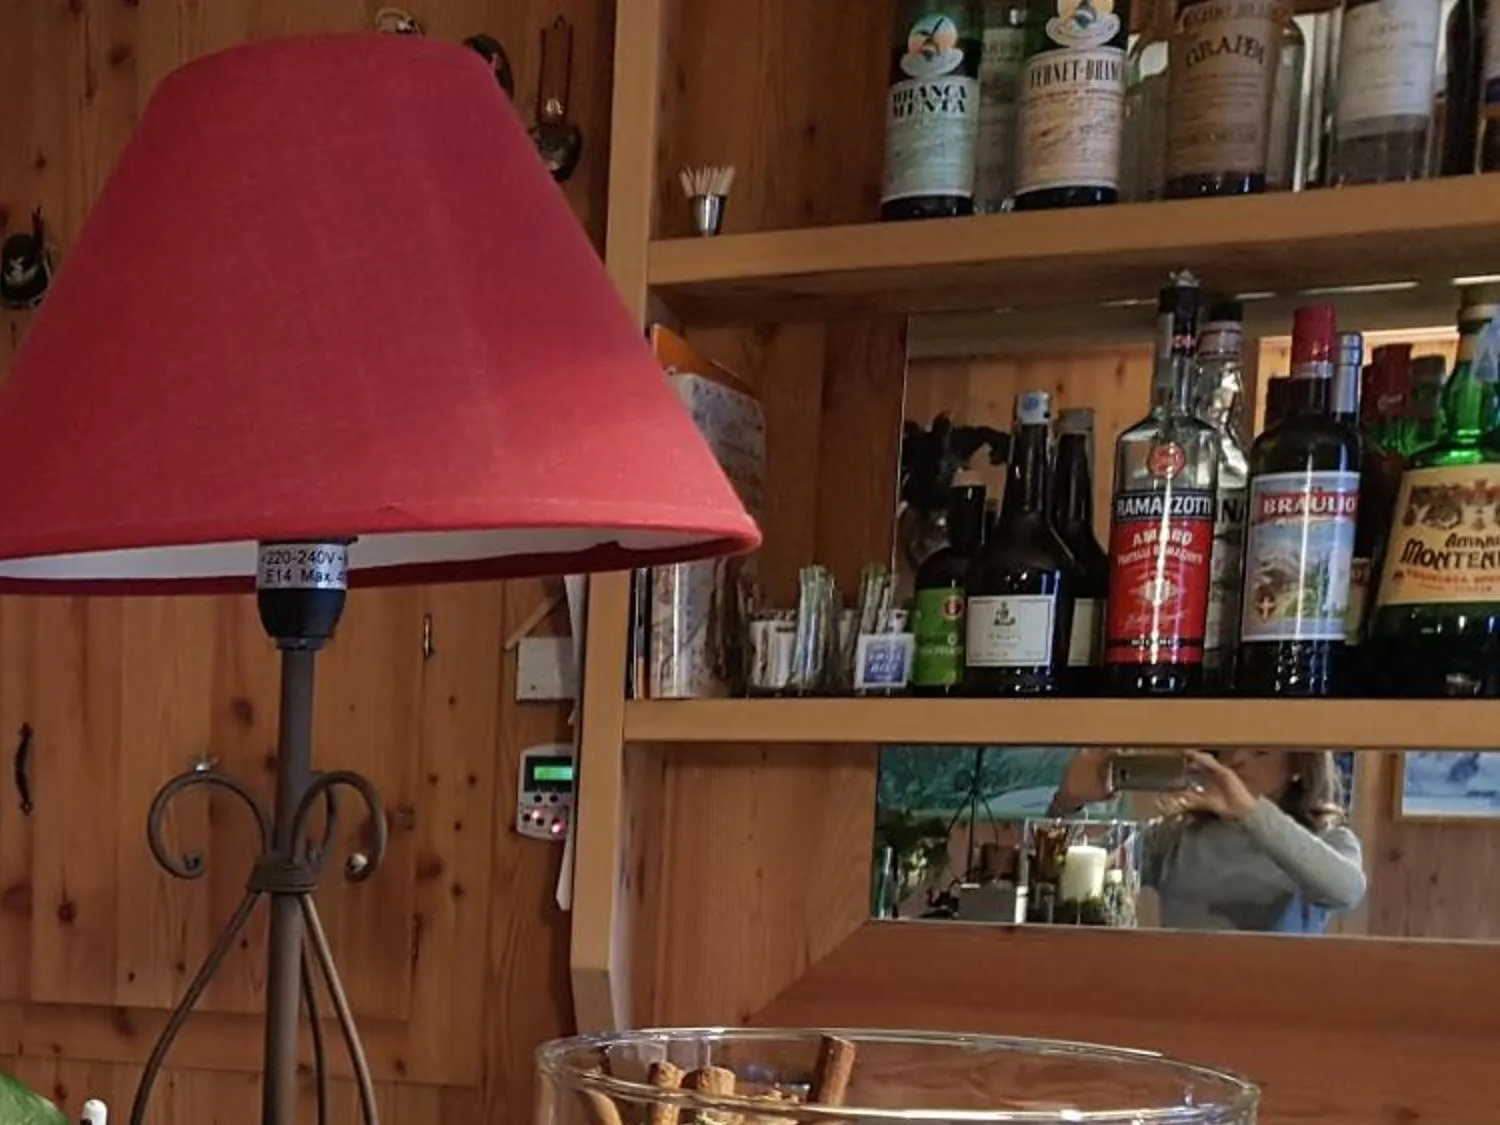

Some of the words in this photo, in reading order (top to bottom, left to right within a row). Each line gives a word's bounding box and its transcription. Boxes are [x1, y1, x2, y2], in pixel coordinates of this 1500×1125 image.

[1262, 493, 1357, 515] BRAULIO
[1132, 528, 1193, 547] AMRO
[1399, 537, 1500, 571] MONTEN
